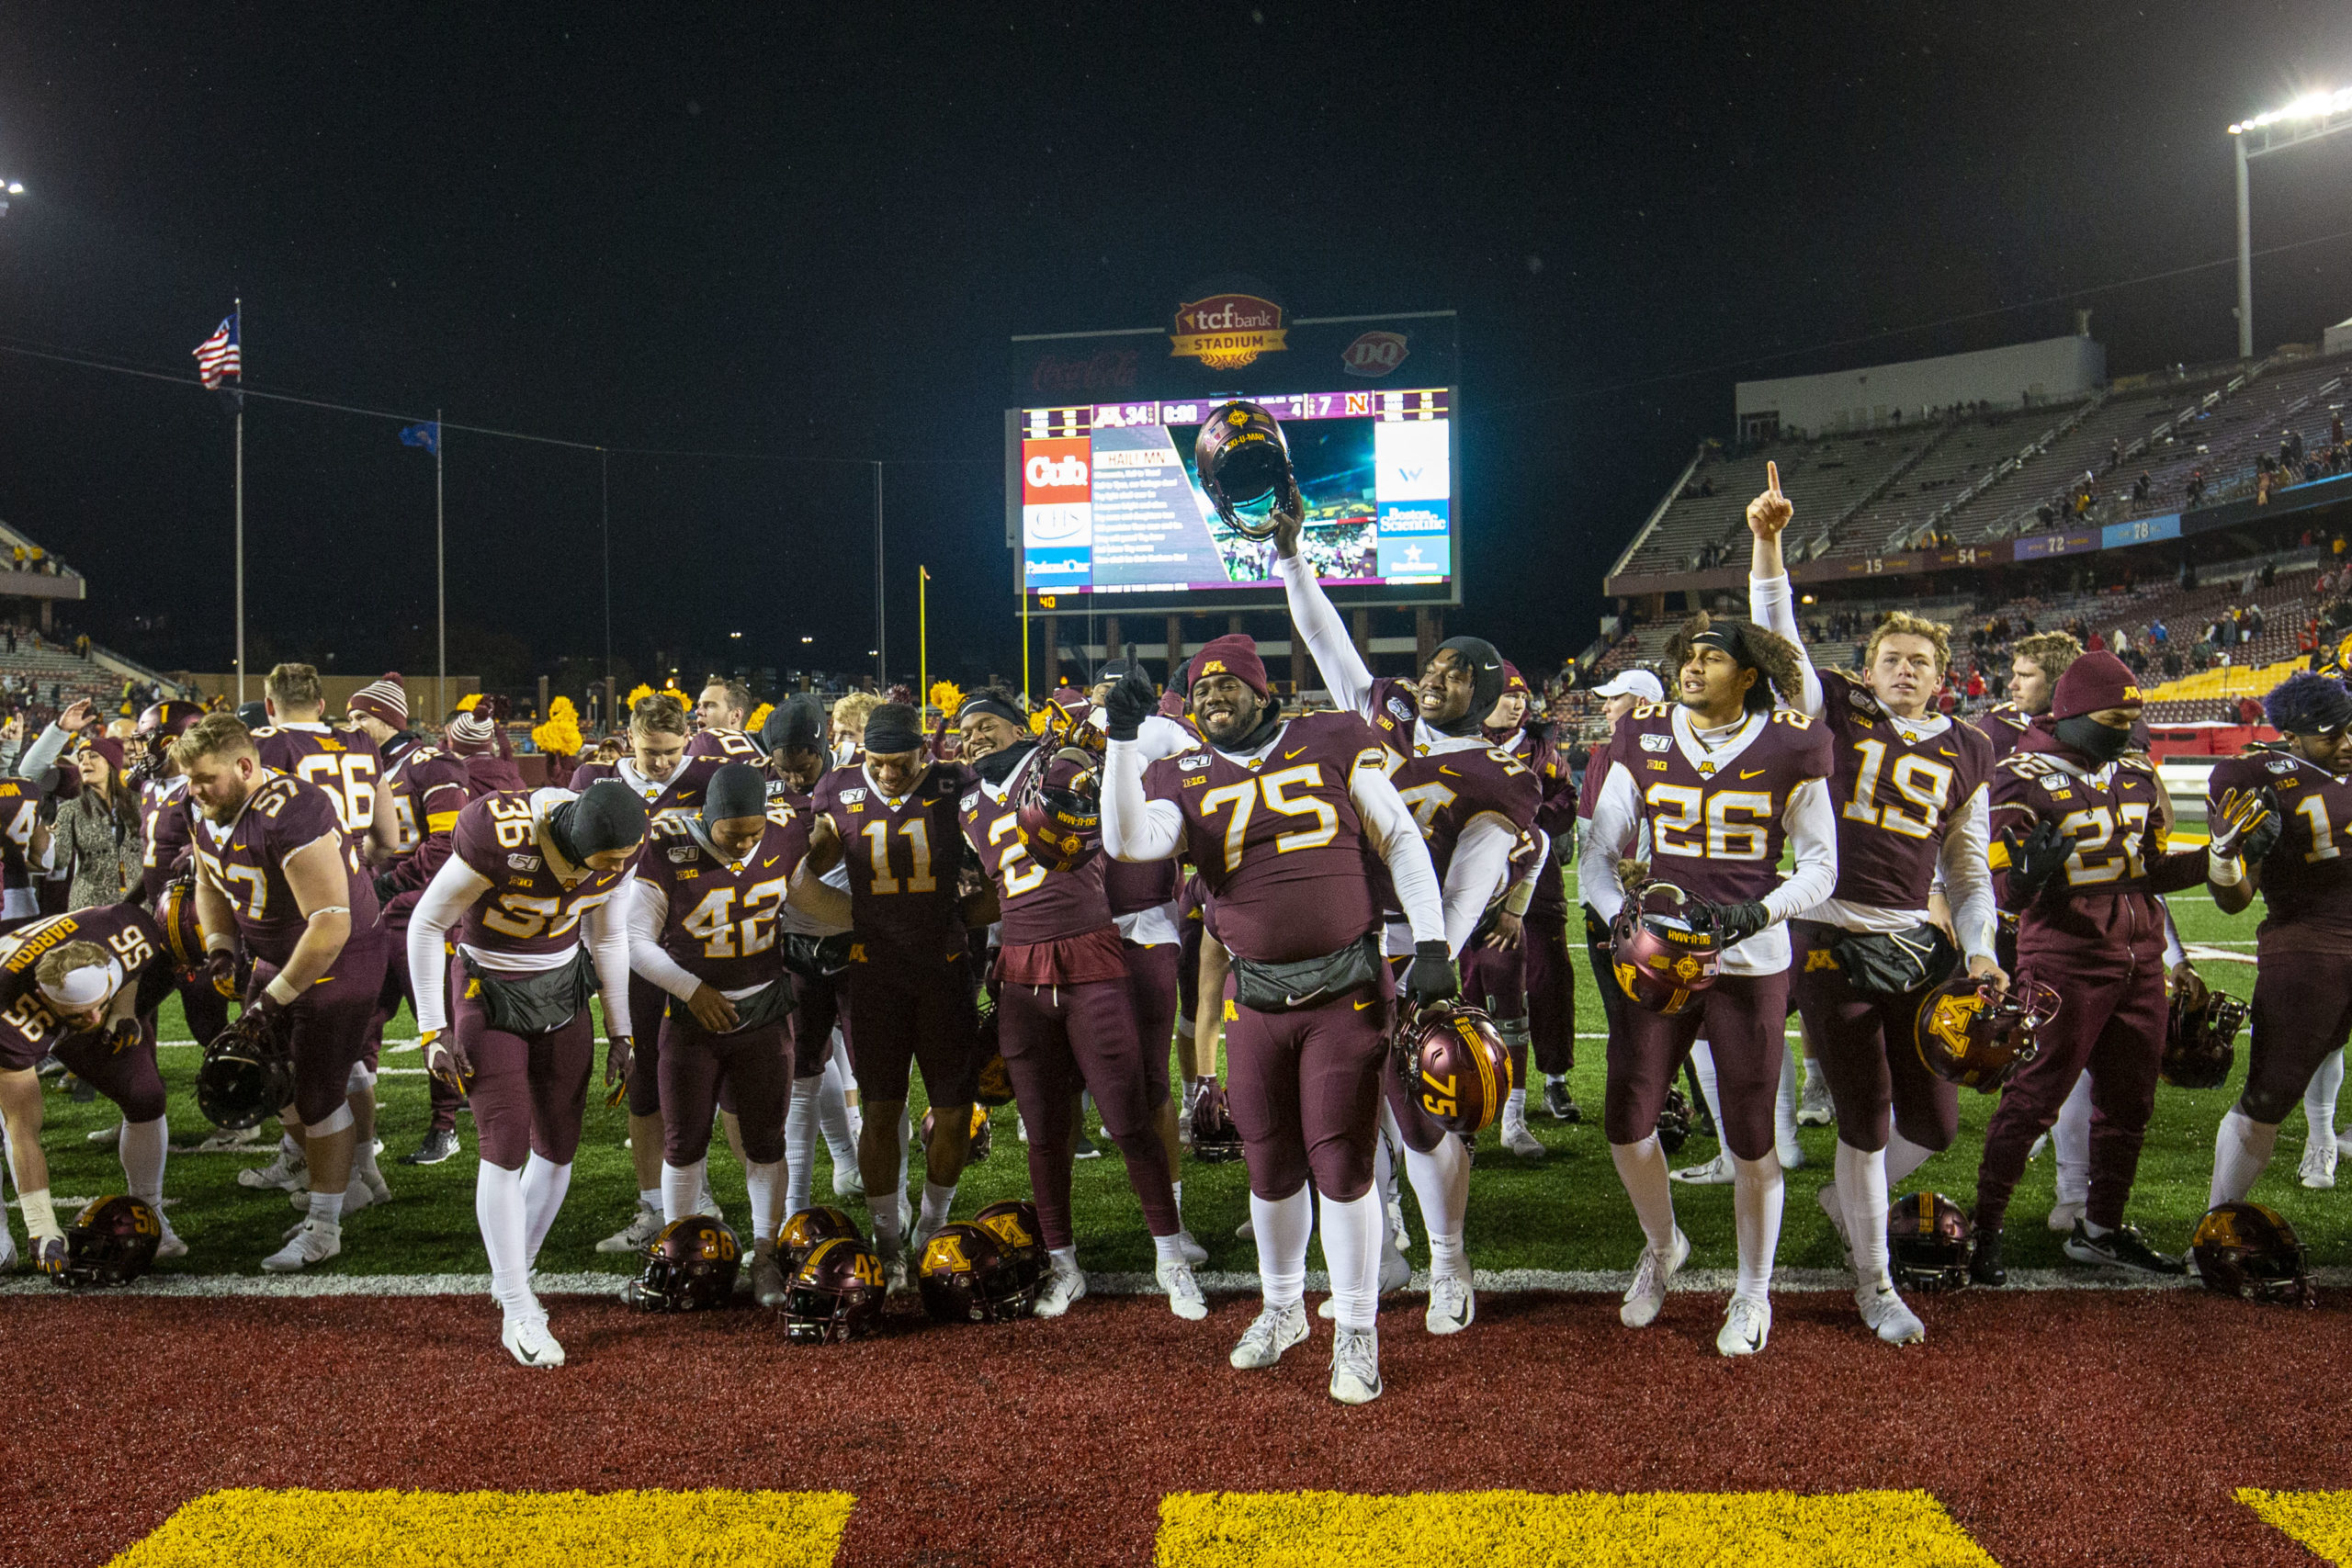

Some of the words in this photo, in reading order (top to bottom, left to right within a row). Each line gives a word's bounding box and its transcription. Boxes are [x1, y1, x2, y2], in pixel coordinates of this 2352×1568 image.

[1194, 335, 1264, 350] STADIUM
[1354, 342, 1398, 365] DQ
[1125, 406, 1148, 425] 34
[1291, 402, 1302, 417] 4
[1318, 396, 1332, 416] 7
[1345, 392, 1369, 415] N
[1226, 433, 1265, 449] SKI-U-MAH
[1144, 451, 1166, 464] MN
[1026, 456, 1088, 487] Cub
[1380, 514, 1446, 532] Scientific
[1388, 507, 1430, 521] Boston
[2134, 522, 2150, 539] 78
[1865, 558, 1883, 573] 15
[1958, 548, 1975, 564] 54
[1039, 595, 1056, 608] 40
[159, 705, 170, 724] 1
[1640, 733, 1674, 752] 150
[251, 778, 300, 818] 57
[1842, 738, 1954, 840] 19
[487, 796, 539, 850] 36
[1057, 810, 1098, 827] SKI-U-MAH
[1200, 763, 1340, 874] 75
[1645, 782, 1772, 860] 26
[142, 809, 160, 868] 1
[2059, 803, 2151, 886] 27
[861, 818, 937, 896] 11
[988, 811, 1048, 899] 2
[681, 874, 788, 959] 42
[5, 917, 80, 975] BARRON
[1668, 929, 1711, 945] SKI-U-MAH
[1422, 1070, 1458, 1118] 75
[699, 1228, 735, 1262] 36
[854, 1253, 885, 1287] 42
